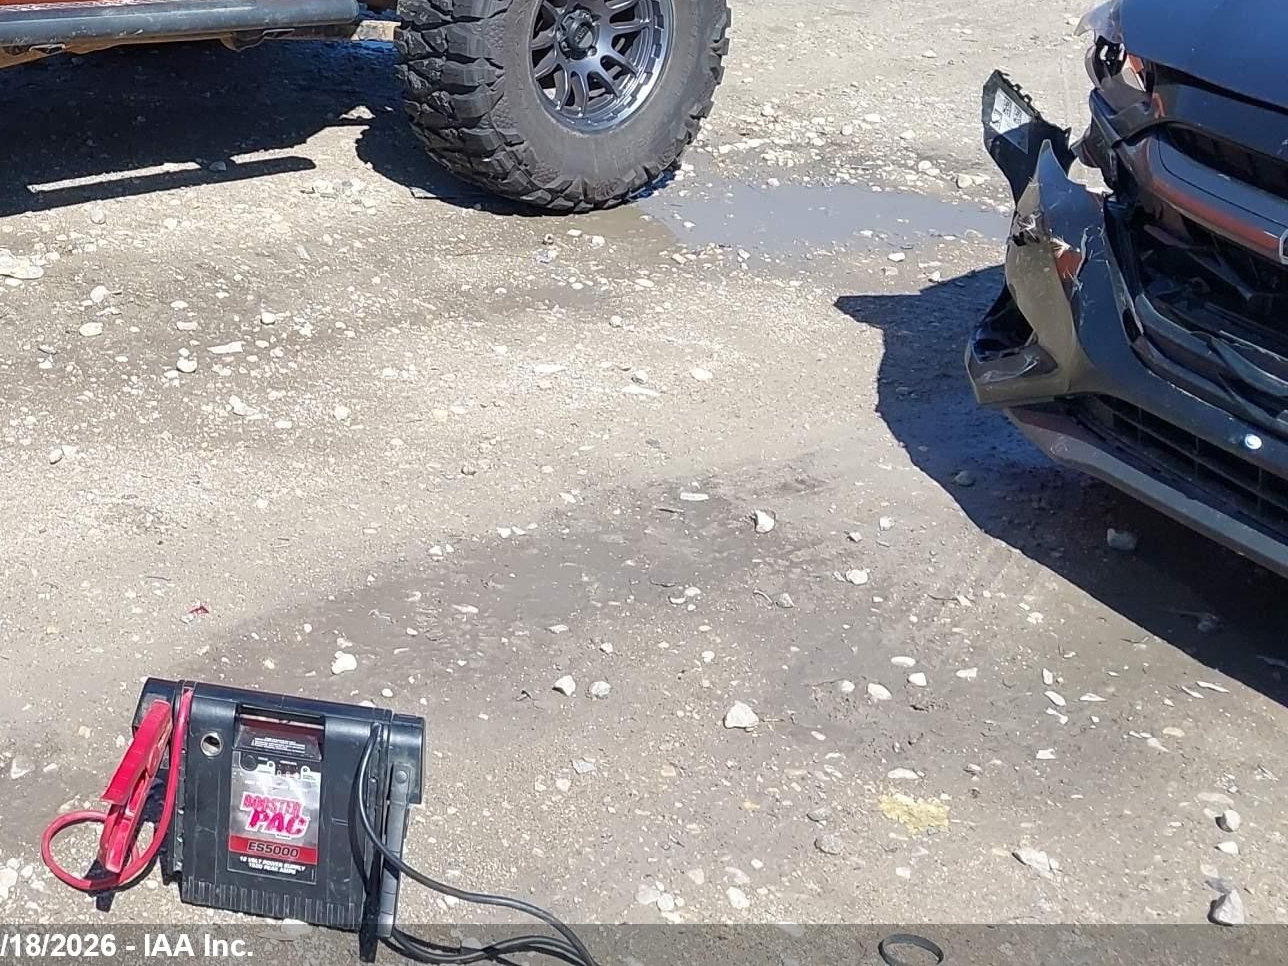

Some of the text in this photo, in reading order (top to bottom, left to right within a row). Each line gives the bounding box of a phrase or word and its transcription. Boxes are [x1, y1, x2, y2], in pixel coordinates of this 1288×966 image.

[248, 808, 309, 835] PAC
[248, 841, 300, 858] ES5000
[262, 859, 283, 868] POWER
